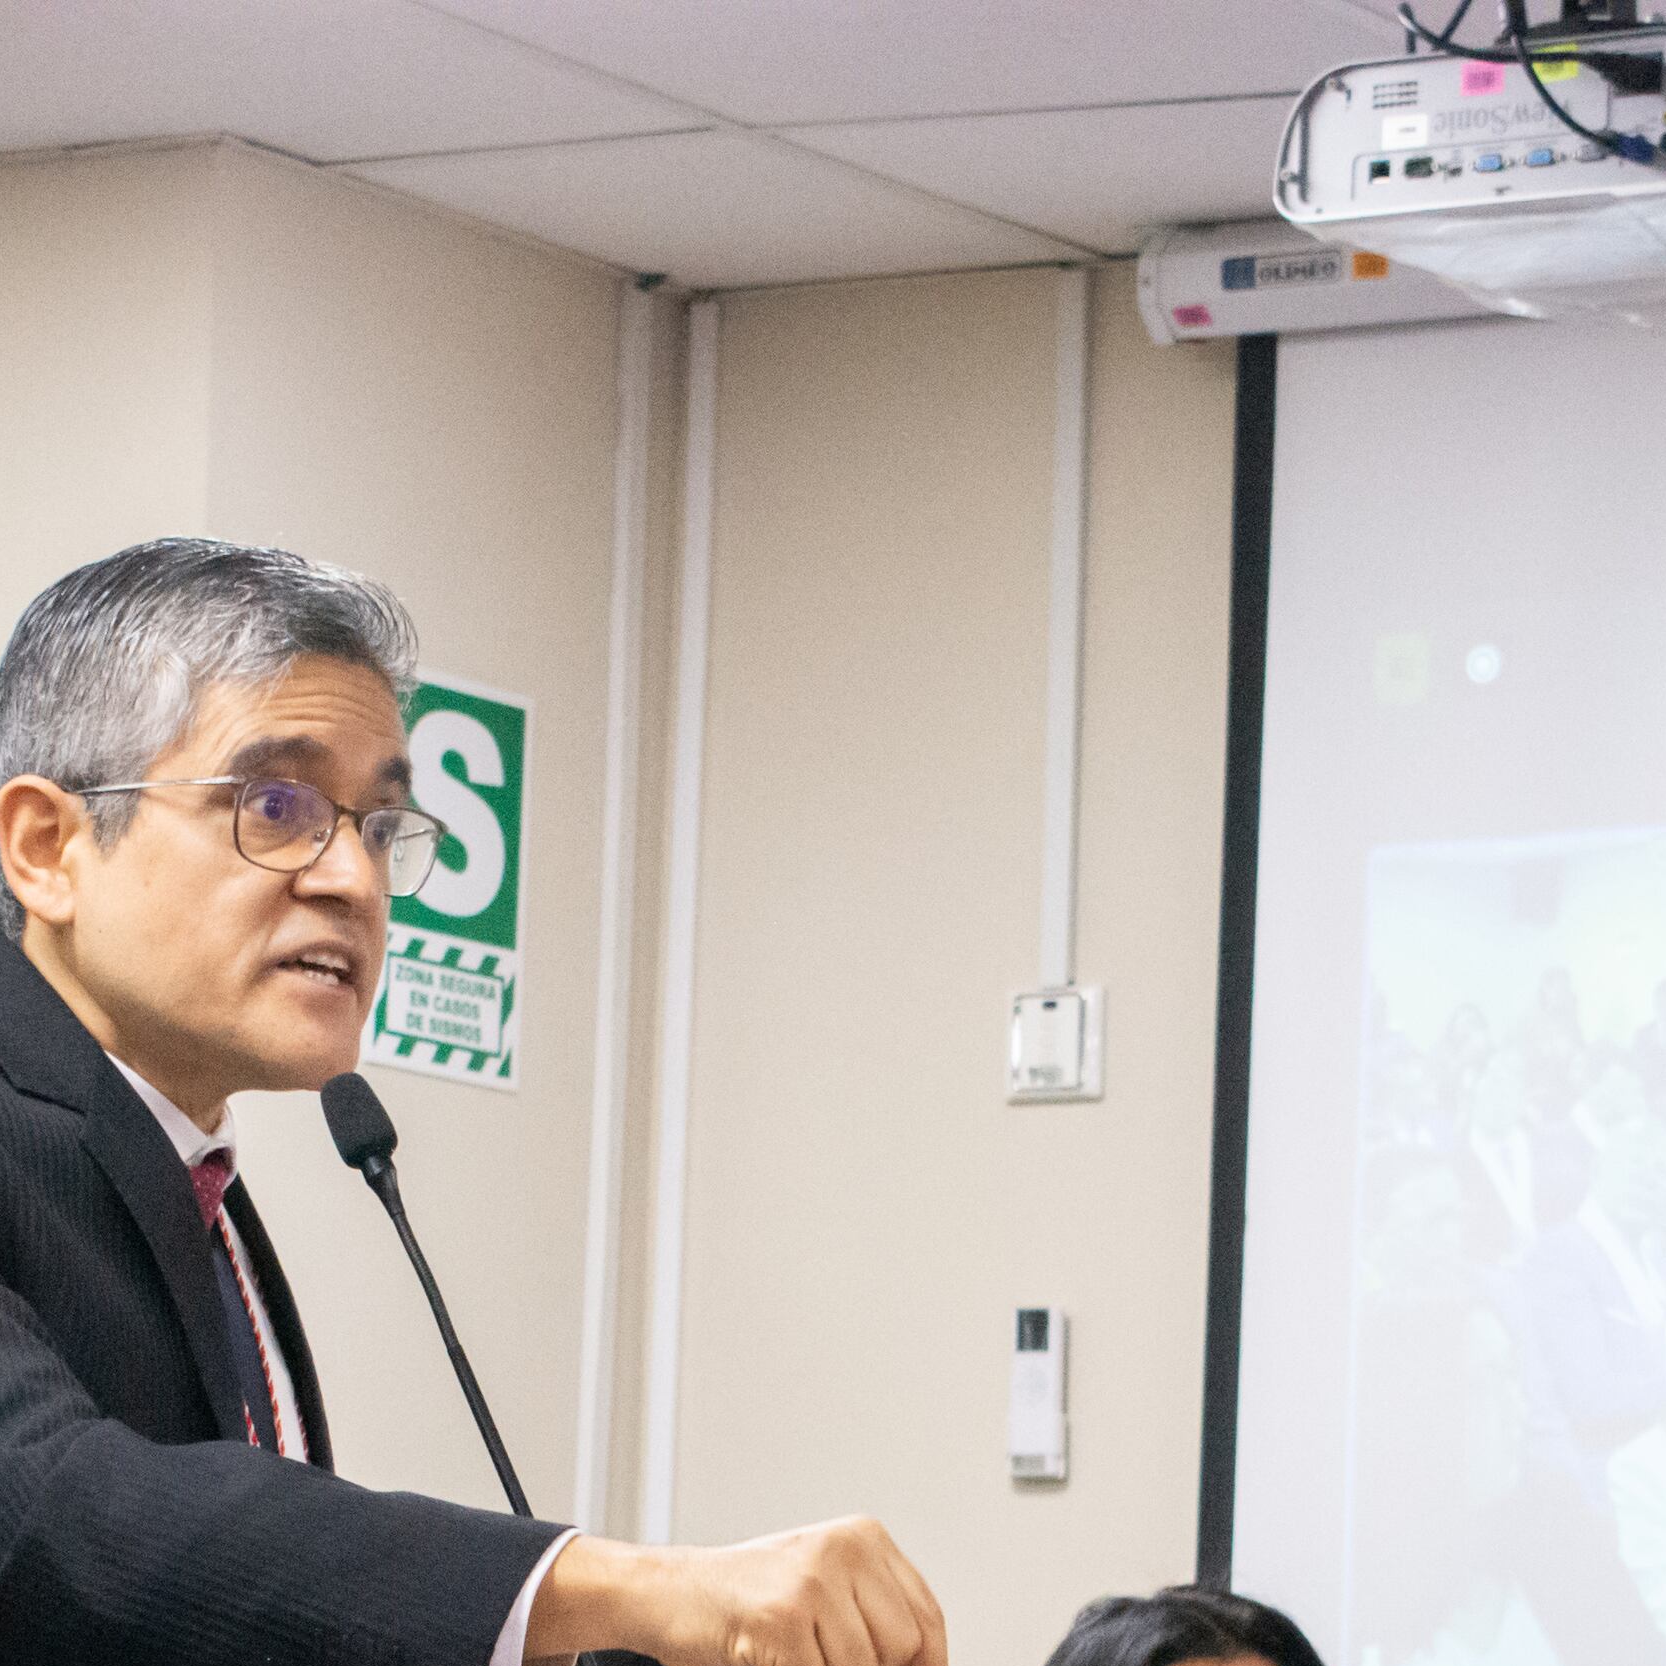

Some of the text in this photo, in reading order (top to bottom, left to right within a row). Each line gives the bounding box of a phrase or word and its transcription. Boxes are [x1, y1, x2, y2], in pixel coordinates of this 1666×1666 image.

[395, 963, 496, 1000] ZONA SEGURA
[409, 989, 480, 1020] EN CASOS
[406, 1012, 482, 1045] DE SISMOS
